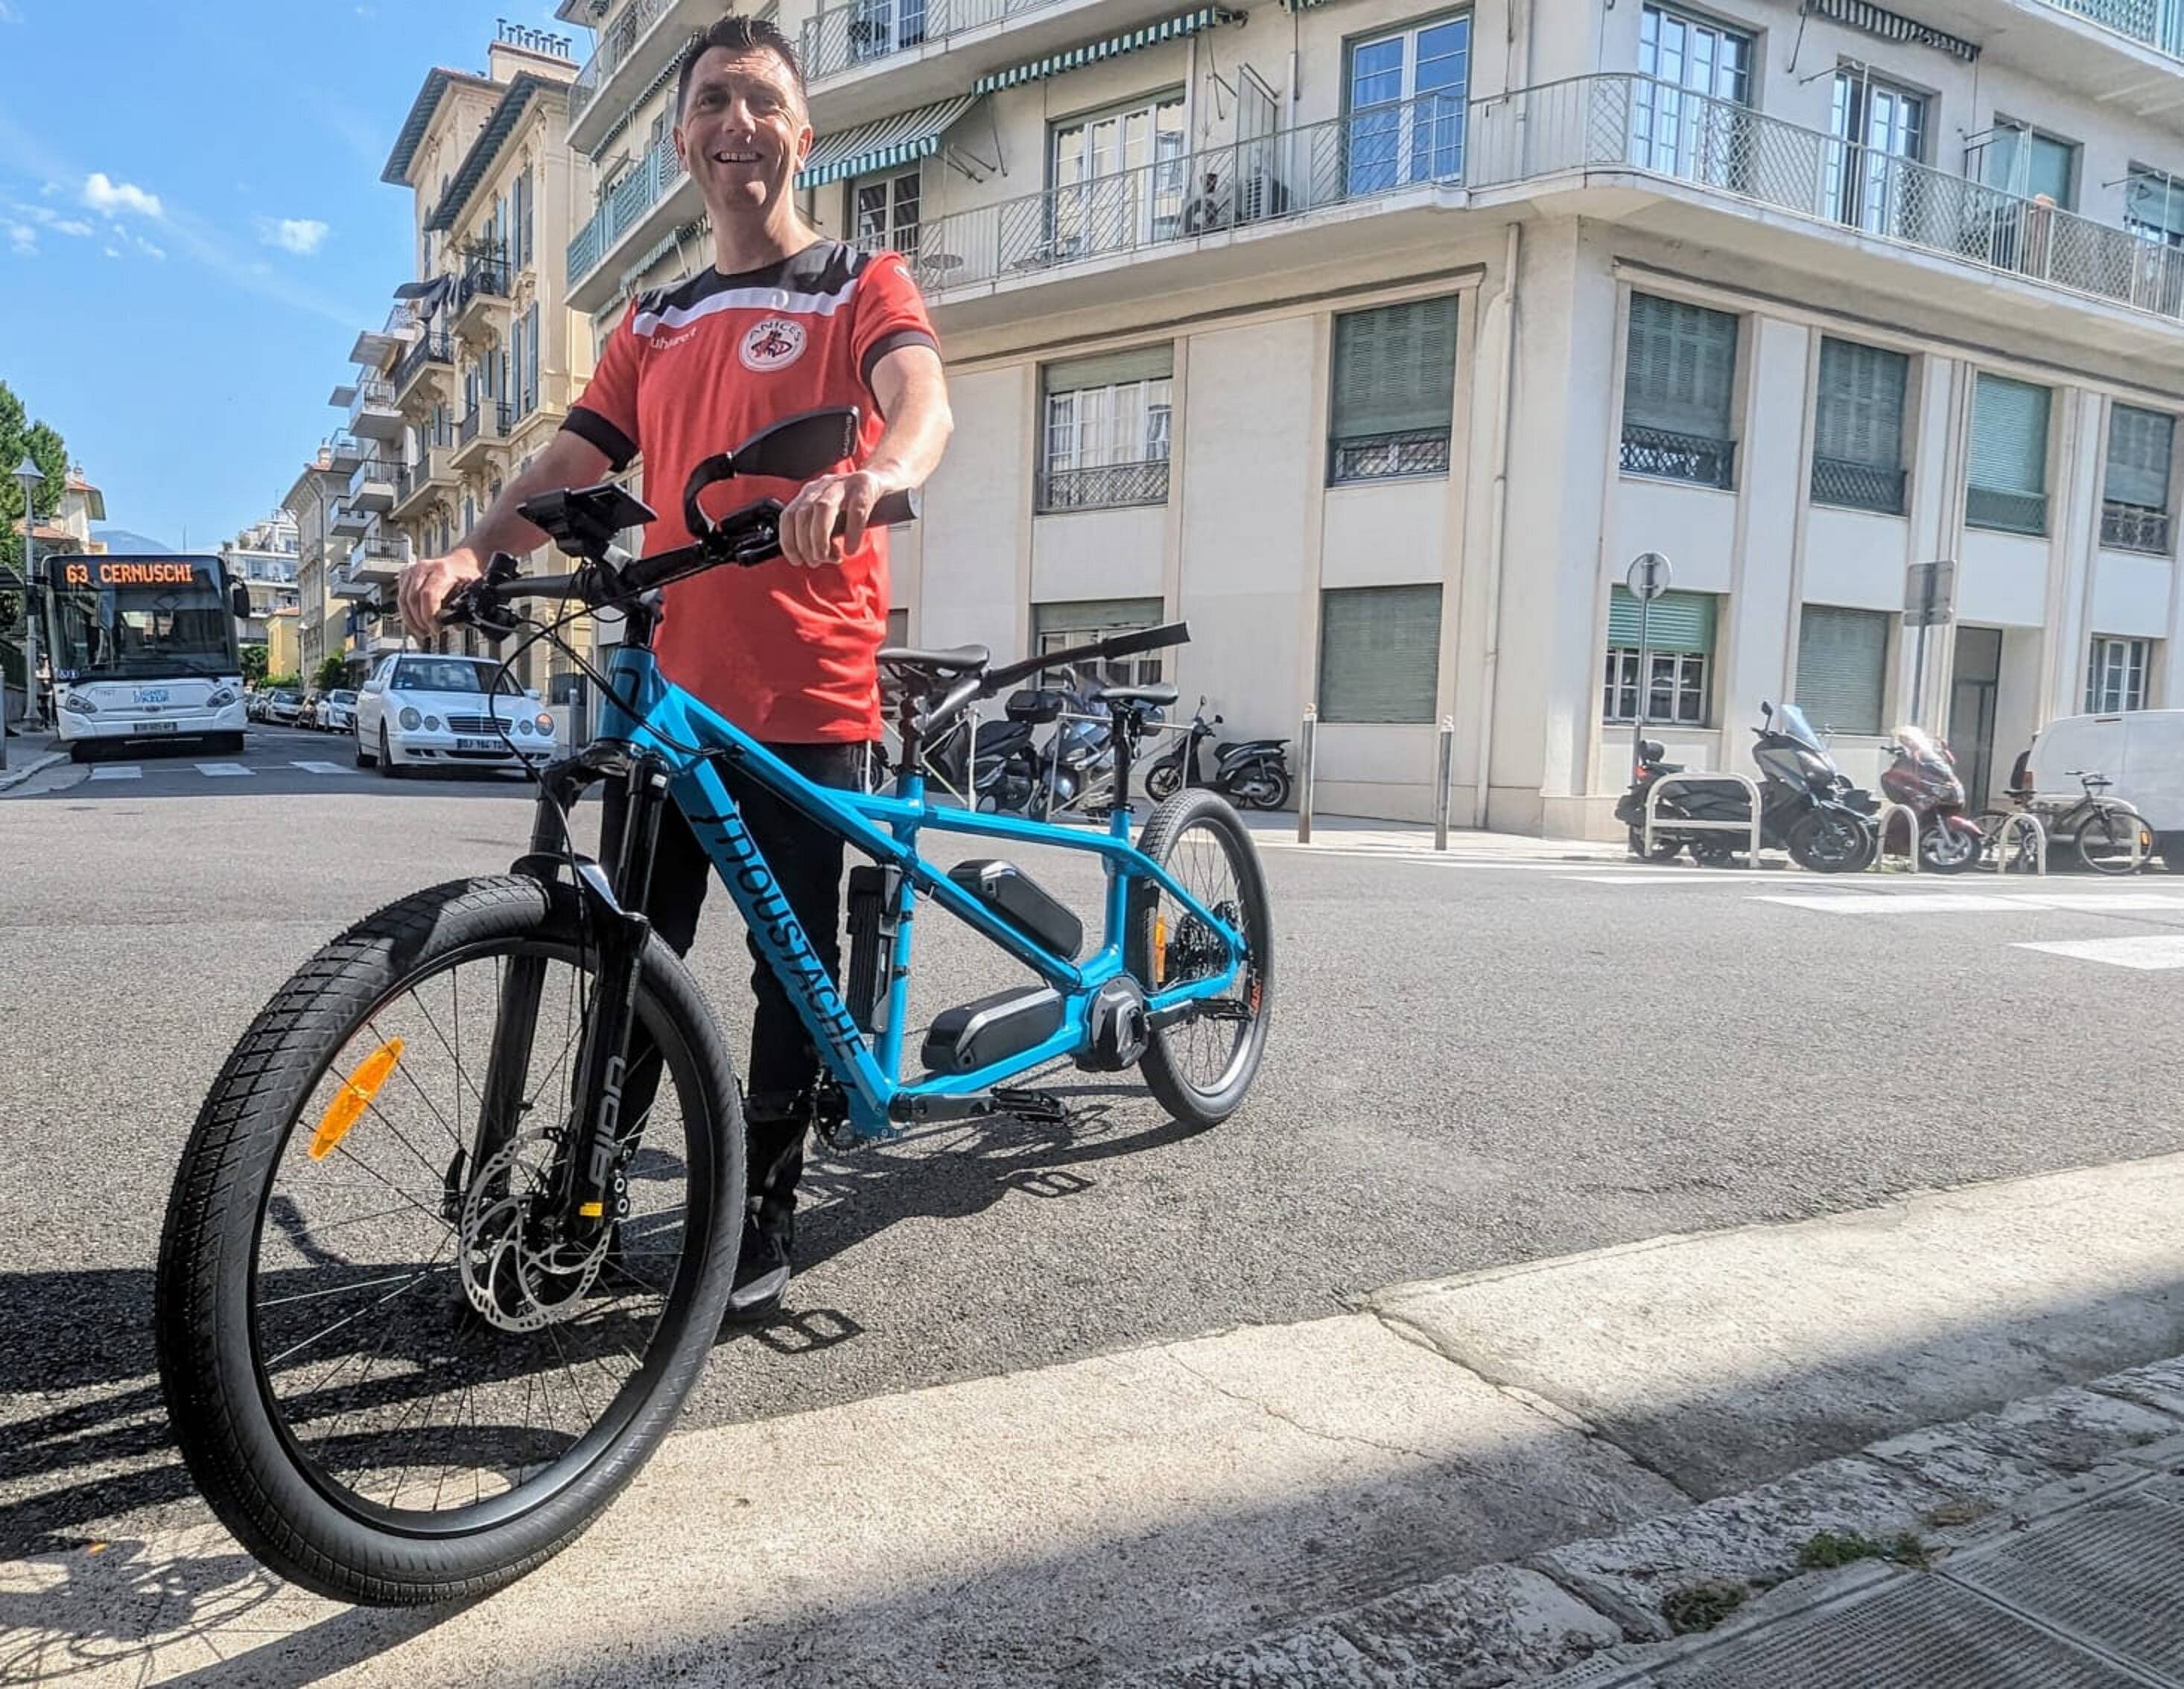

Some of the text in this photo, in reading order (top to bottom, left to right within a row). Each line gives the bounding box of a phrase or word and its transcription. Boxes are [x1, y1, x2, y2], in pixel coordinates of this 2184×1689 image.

[66, 564, 193, 583] 63 CERNUSCHI
[687, 812, 868, 1058] MOUSTACHE
